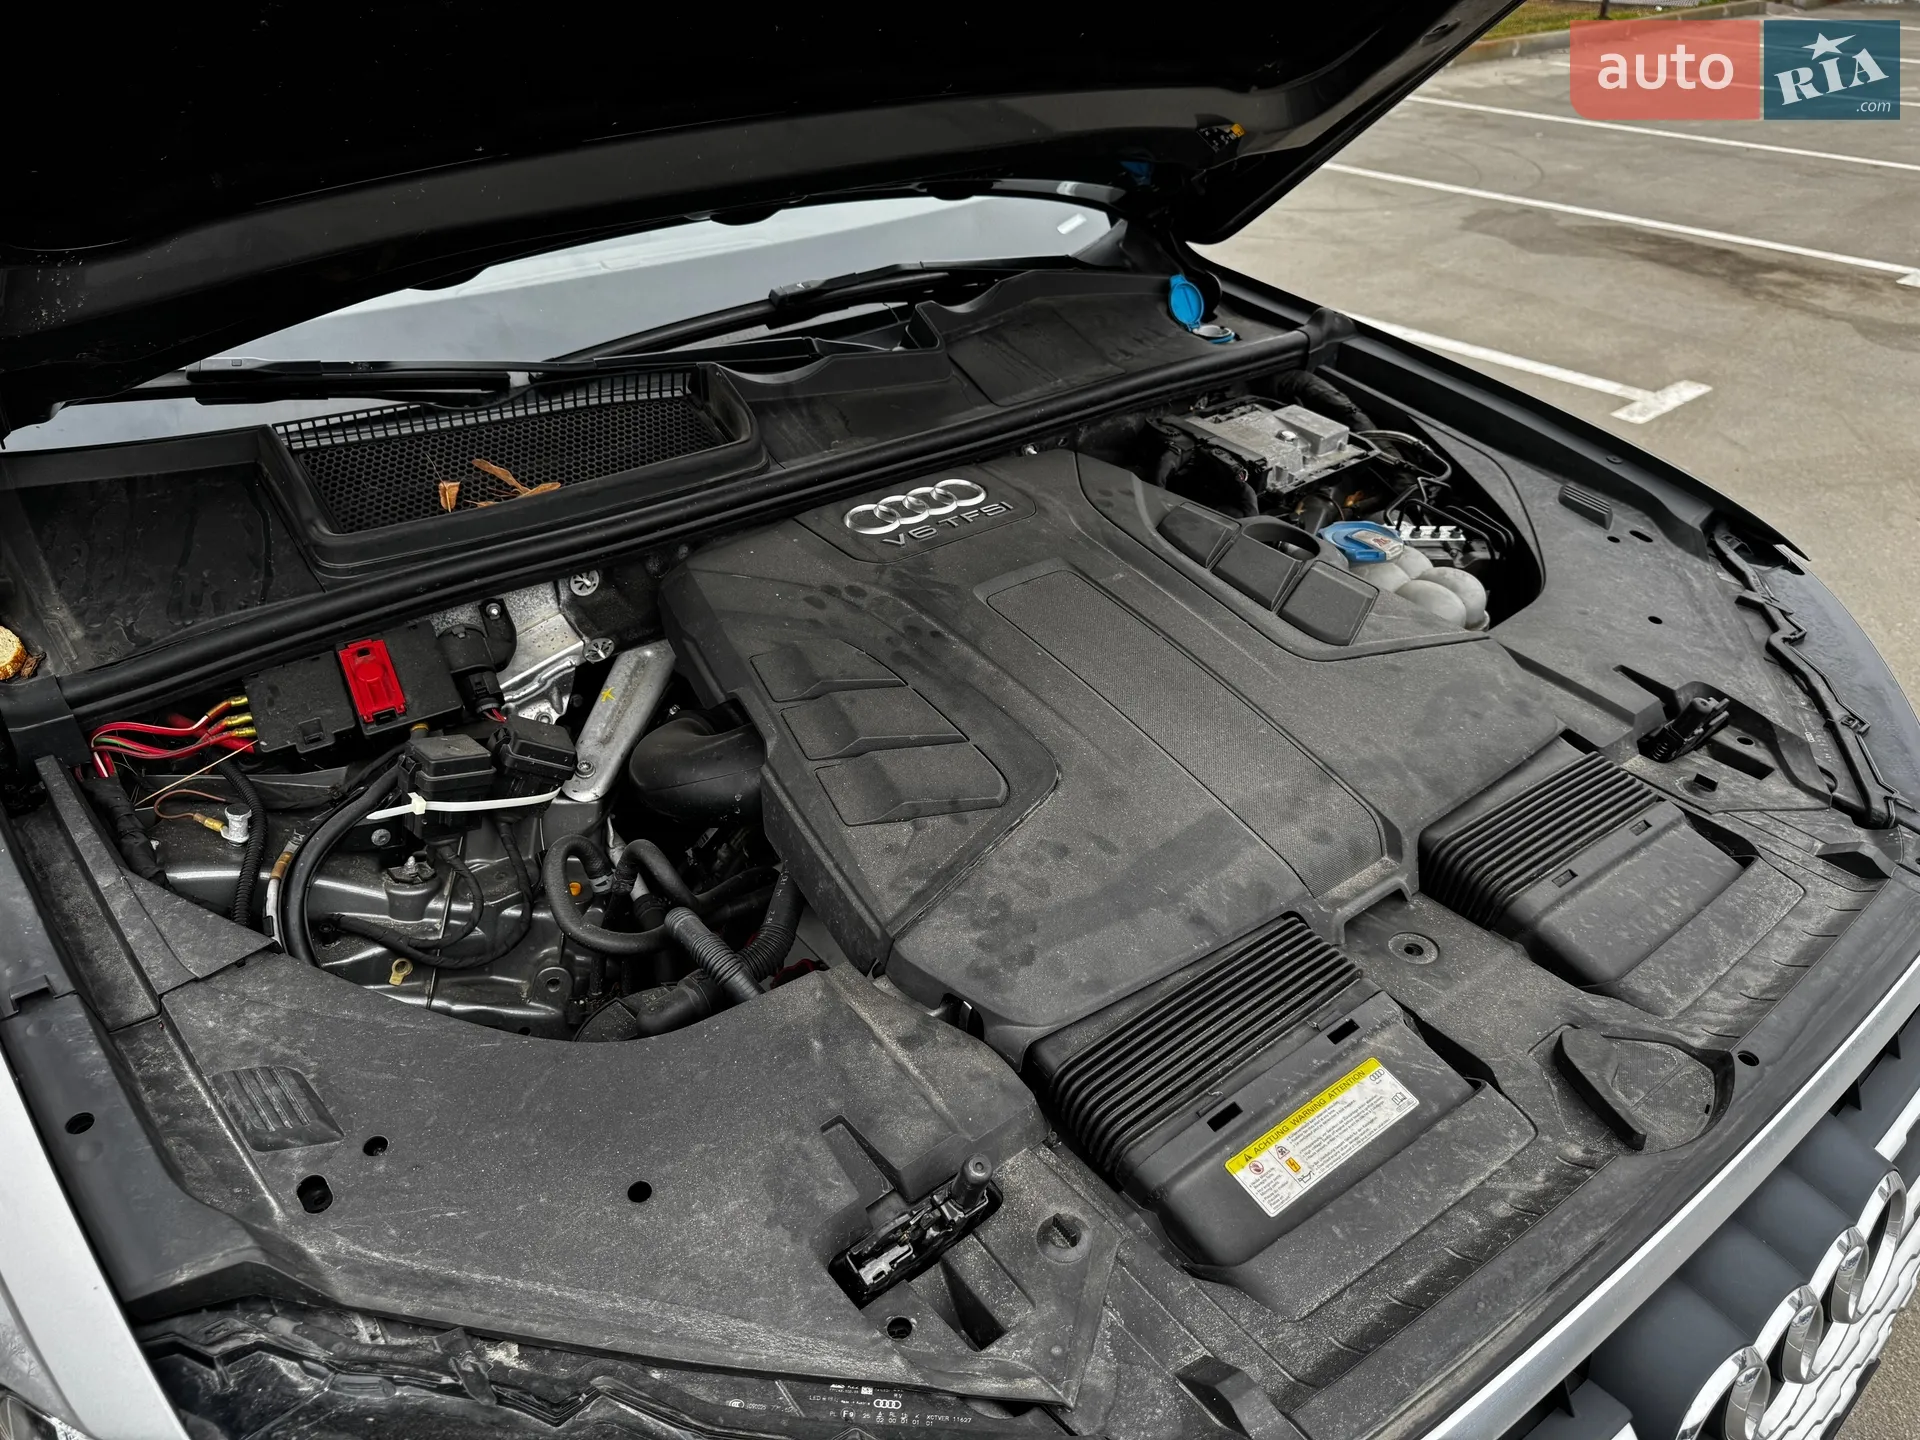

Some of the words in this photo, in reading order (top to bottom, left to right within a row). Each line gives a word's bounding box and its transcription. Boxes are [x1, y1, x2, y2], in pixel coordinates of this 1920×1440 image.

[882, 524, 939, 547] V6
[937, 501, 1014, 528] TFSI
[1253, 1125, 1290, 1155] ACHTUNG
[1291, 1098, 1327, 1127] WARNING
[1328, 1070, 1366, 1100] ATTENTION
